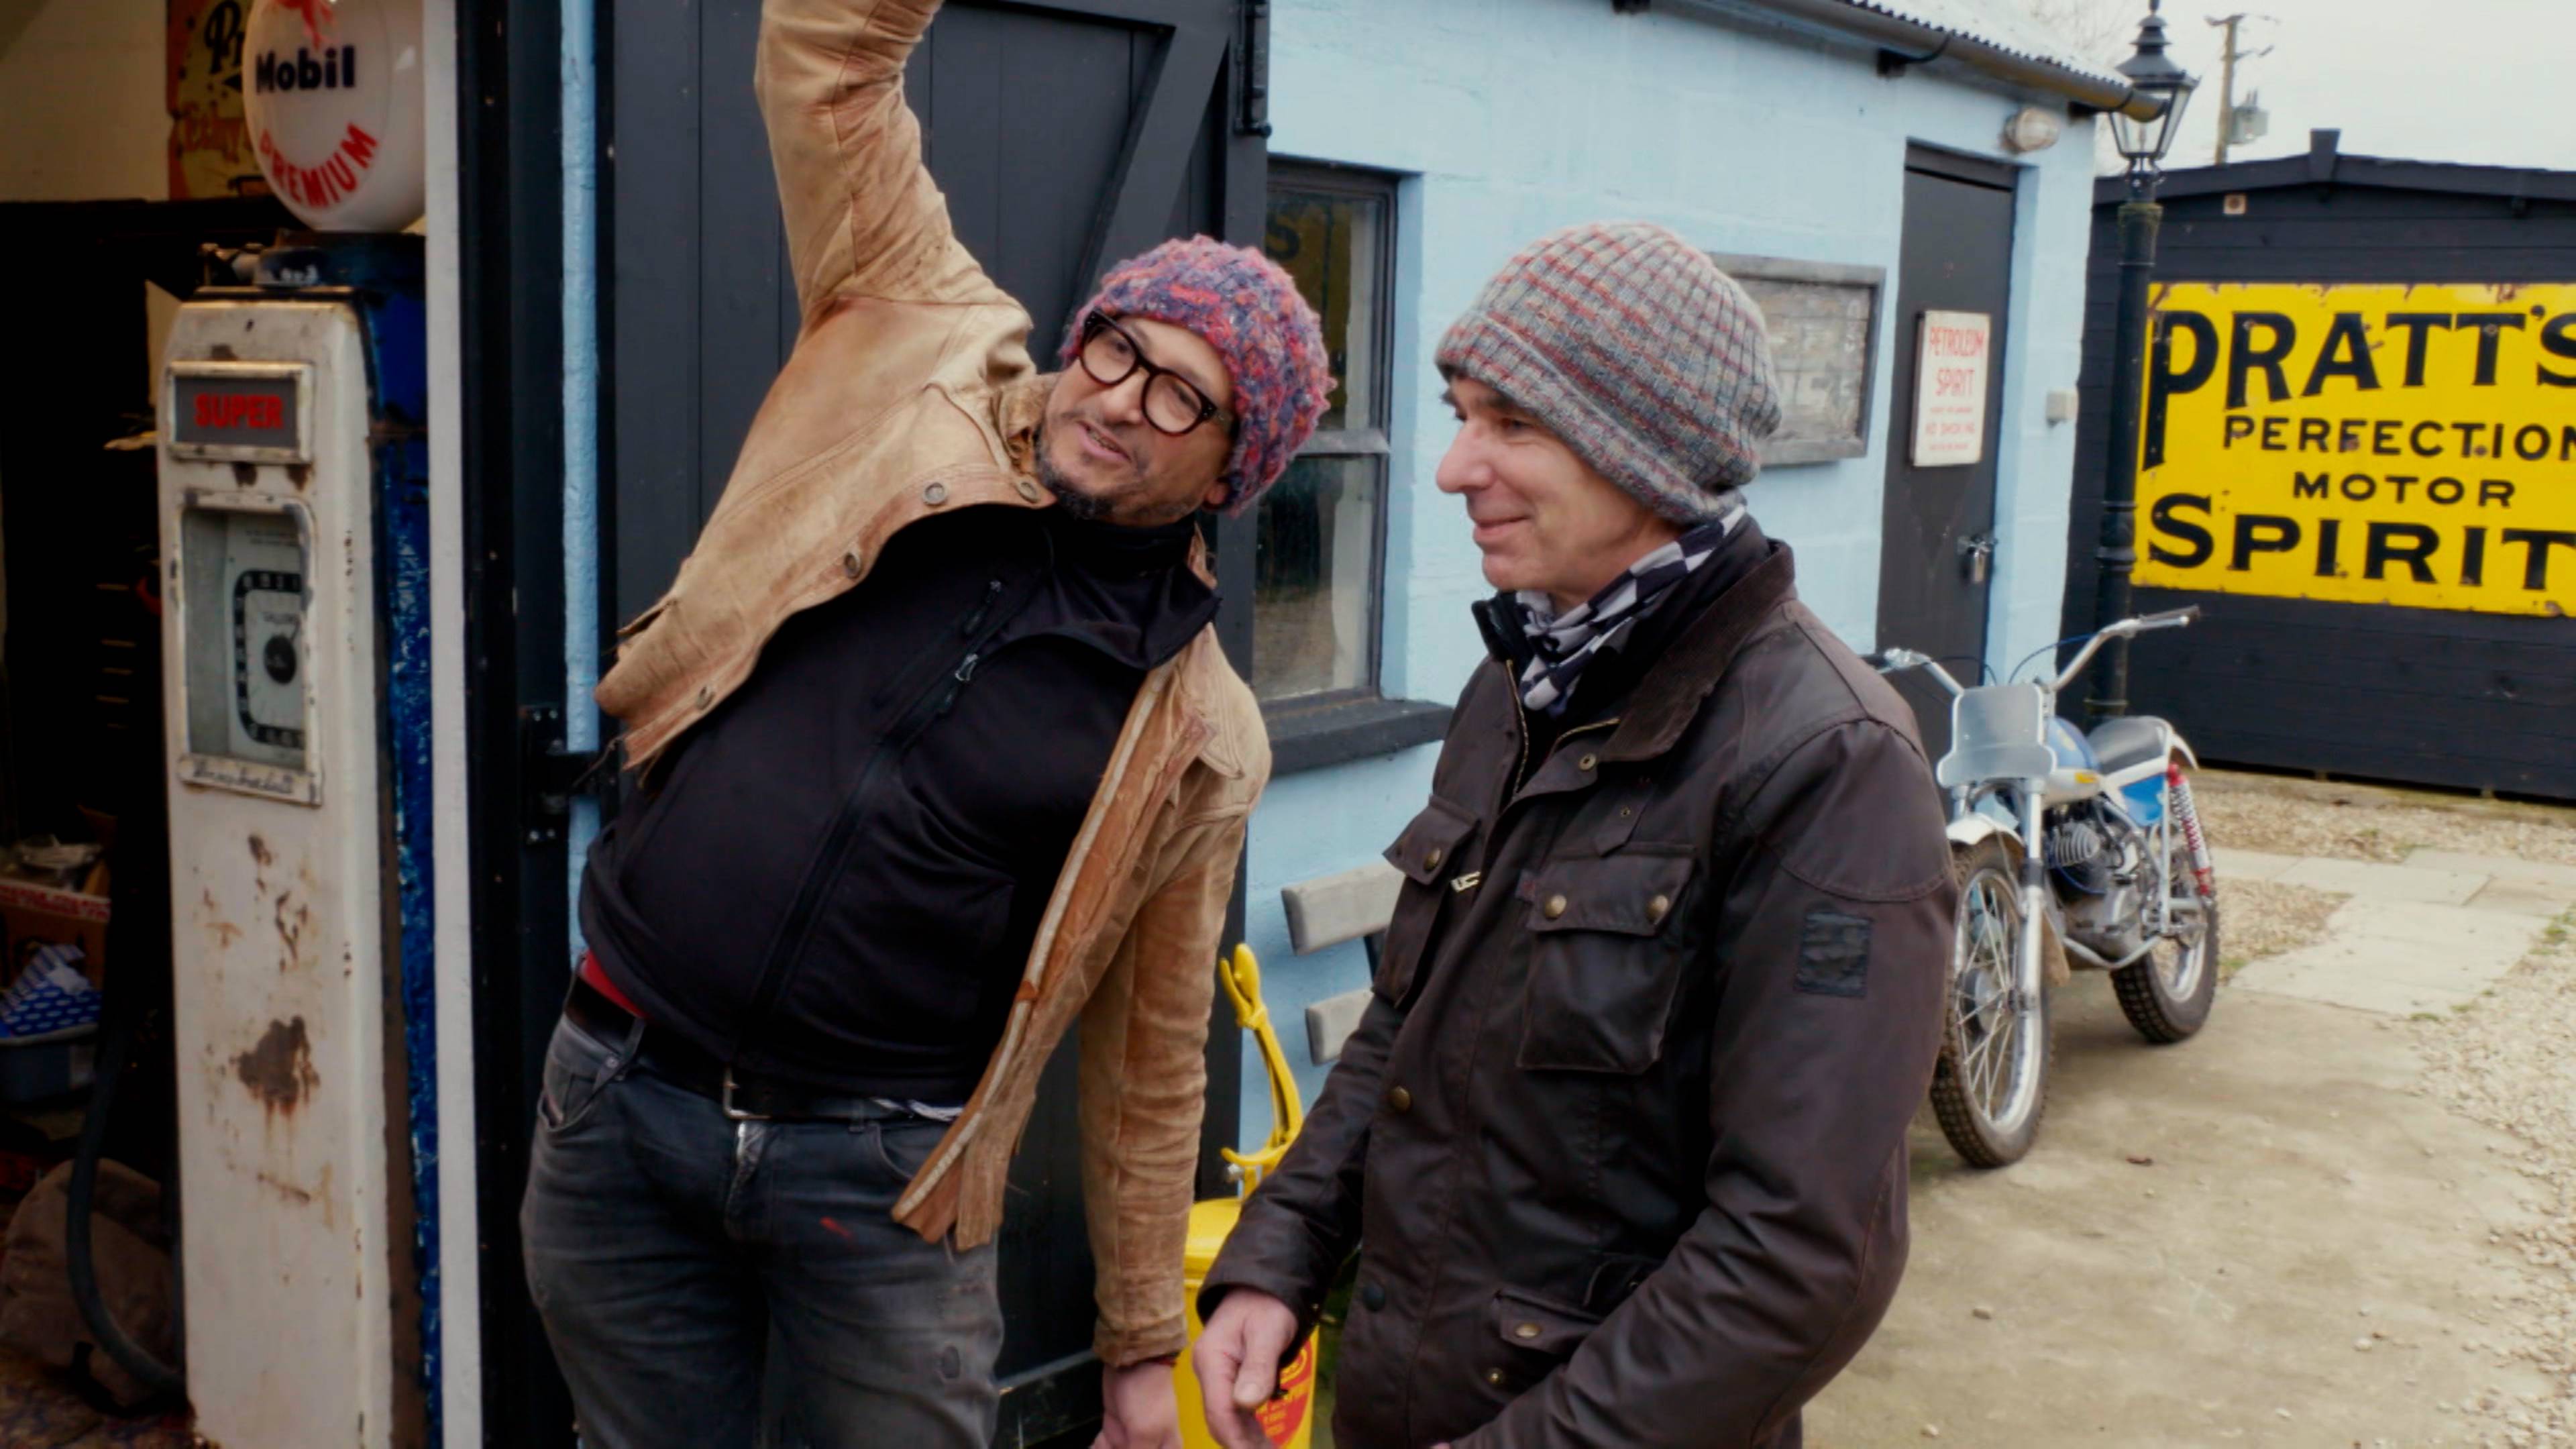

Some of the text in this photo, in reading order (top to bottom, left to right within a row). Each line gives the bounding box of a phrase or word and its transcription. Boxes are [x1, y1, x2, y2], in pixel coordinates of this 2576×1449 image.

[256, 45, 356, 94] Mobil
[259, 123, 378, 209] PREMIUM
[194, 393, 284, 429] SUPER
[2142, 305, 2576, 471] PRATT'S
[2292, 472, 2516, 508] MOTOR
[2148, 493, 2576, 591] SPIRIT
